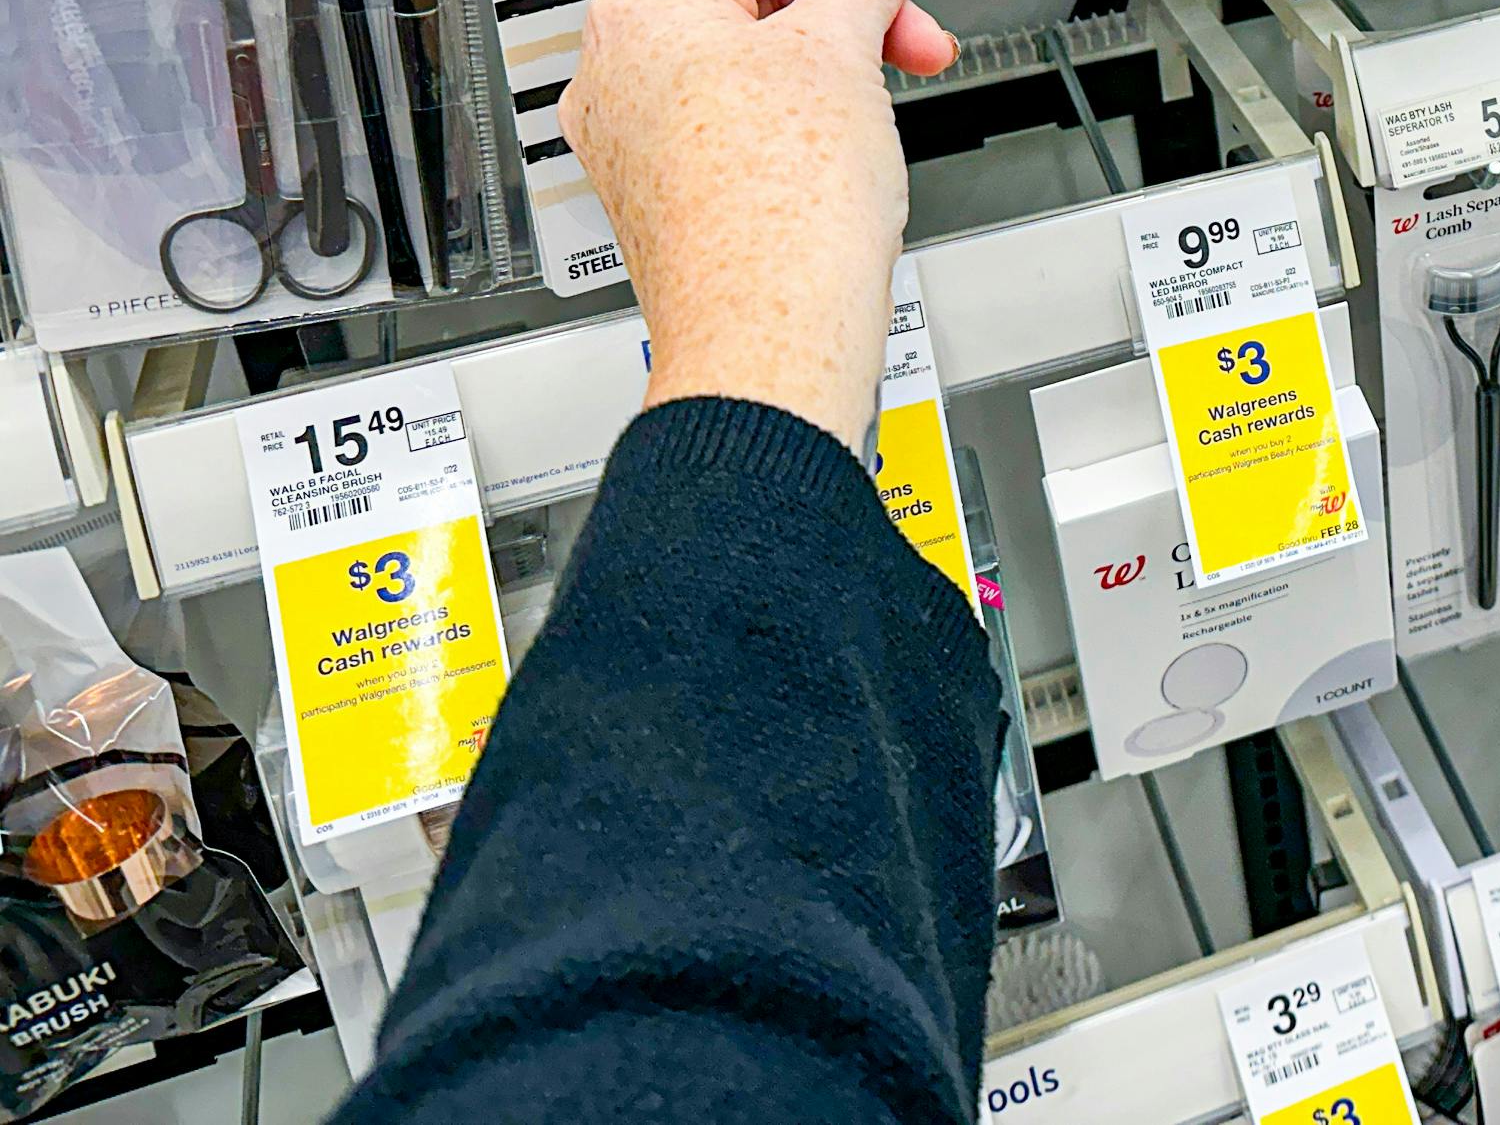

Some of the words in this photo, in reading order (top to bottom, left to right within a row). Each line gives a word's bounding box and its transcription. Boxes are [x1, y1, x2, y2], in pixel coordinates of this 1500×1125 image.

[1385, 113, 1409, 127] WAG
[1408, 108, 1427, 123] BTY
[1427, 100, 1453, 118] LASH
[1388, 118, 1442, 138] SEPERATOR
[1425, 219, 1473, 241] Comb
[1426, 206, 1464, 225] Lash
[568, 252, 624, 282] STEEL
[571, 244, 615, 263] STAINLESS
[1149, 278, 1176, 291] WALG
[1177, 272, 1197, 285] BTY
[1198, 261, 1244, 280] COMPACT
[1151, 287, 1170, 299] LED
[1171, 279, 1208, 294] MIRROR
[1217, 341, 1271, 387] $3
[1208, 387, 1298, 422] Walgreens
[1198, 424, 1243, 447] Cash
[1246, 404, 1316, 434] rewards
[269, 483, 305, 498] WALG
[307, 479, 317, 491] B
[319, 467, 362, 486] FACIAL
[271, 486, 339, 508] CLEANSING
[341, 472, 383, 492] BRUSH
[348, 551, 416, 604] $3
[1218, 582, 1290, 609] magnification
[332, 605, 449, 647] Walgreens
[1182, 612, 1253, 642] Rechargeable
[316, 650, 375, 677] Cash
[381, 622, 472, 660] rewards
[1325, 677, 1374, 705] COUNT
